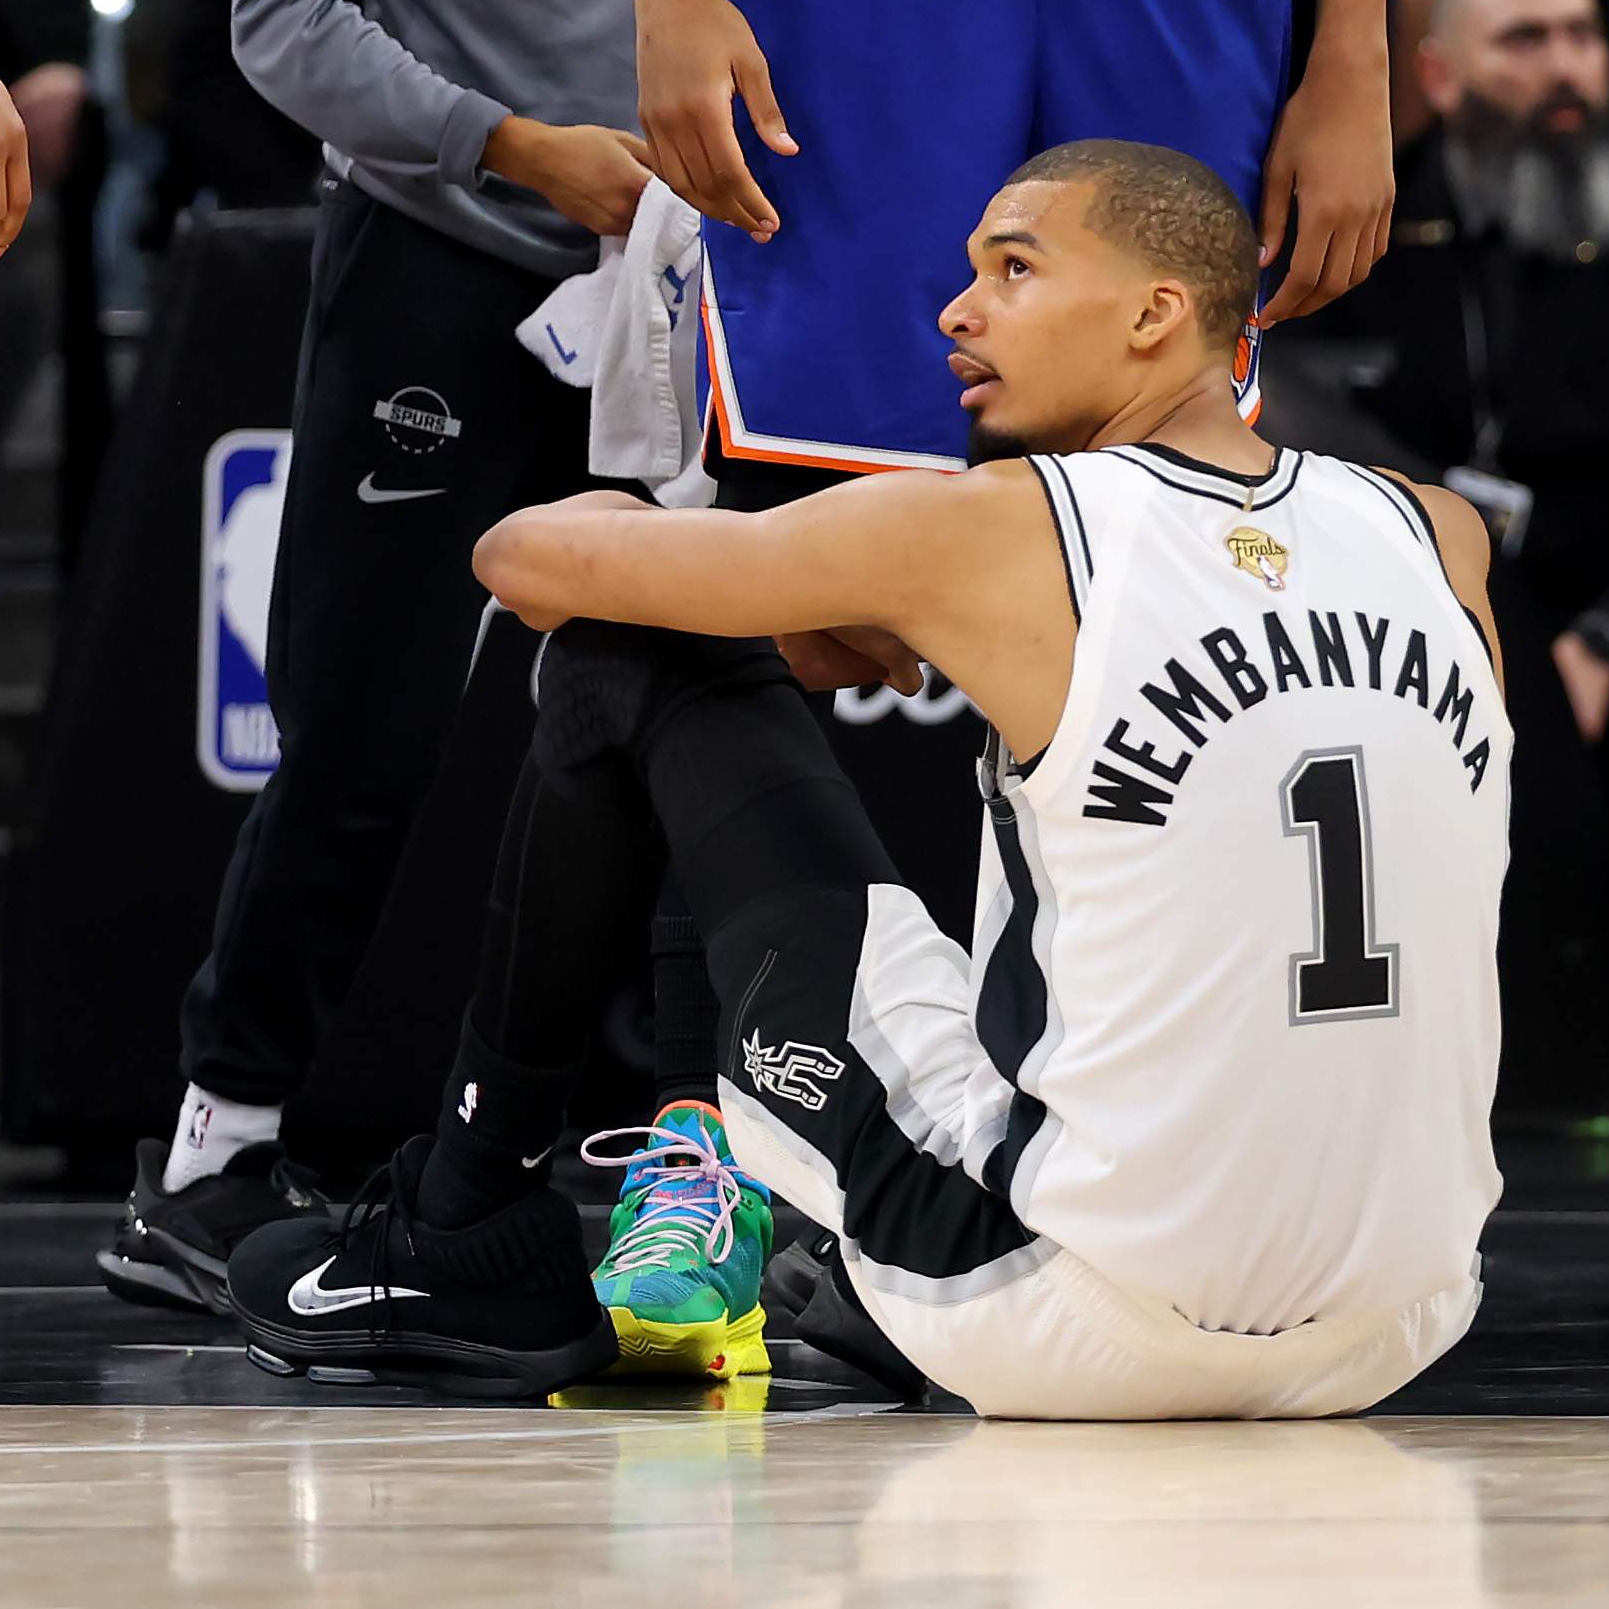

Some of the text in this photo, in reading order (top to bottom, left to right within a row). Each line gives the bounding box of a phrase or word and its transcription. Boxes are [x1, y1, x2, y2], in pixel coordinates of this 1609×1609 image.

[391, 403, 446, 435] SPURS
[1227, 536, 1287, 567] Finals
[1082, 609, 1491, 828] WEMBANYAMA
[1279, 744, 1400, 1028] 1
